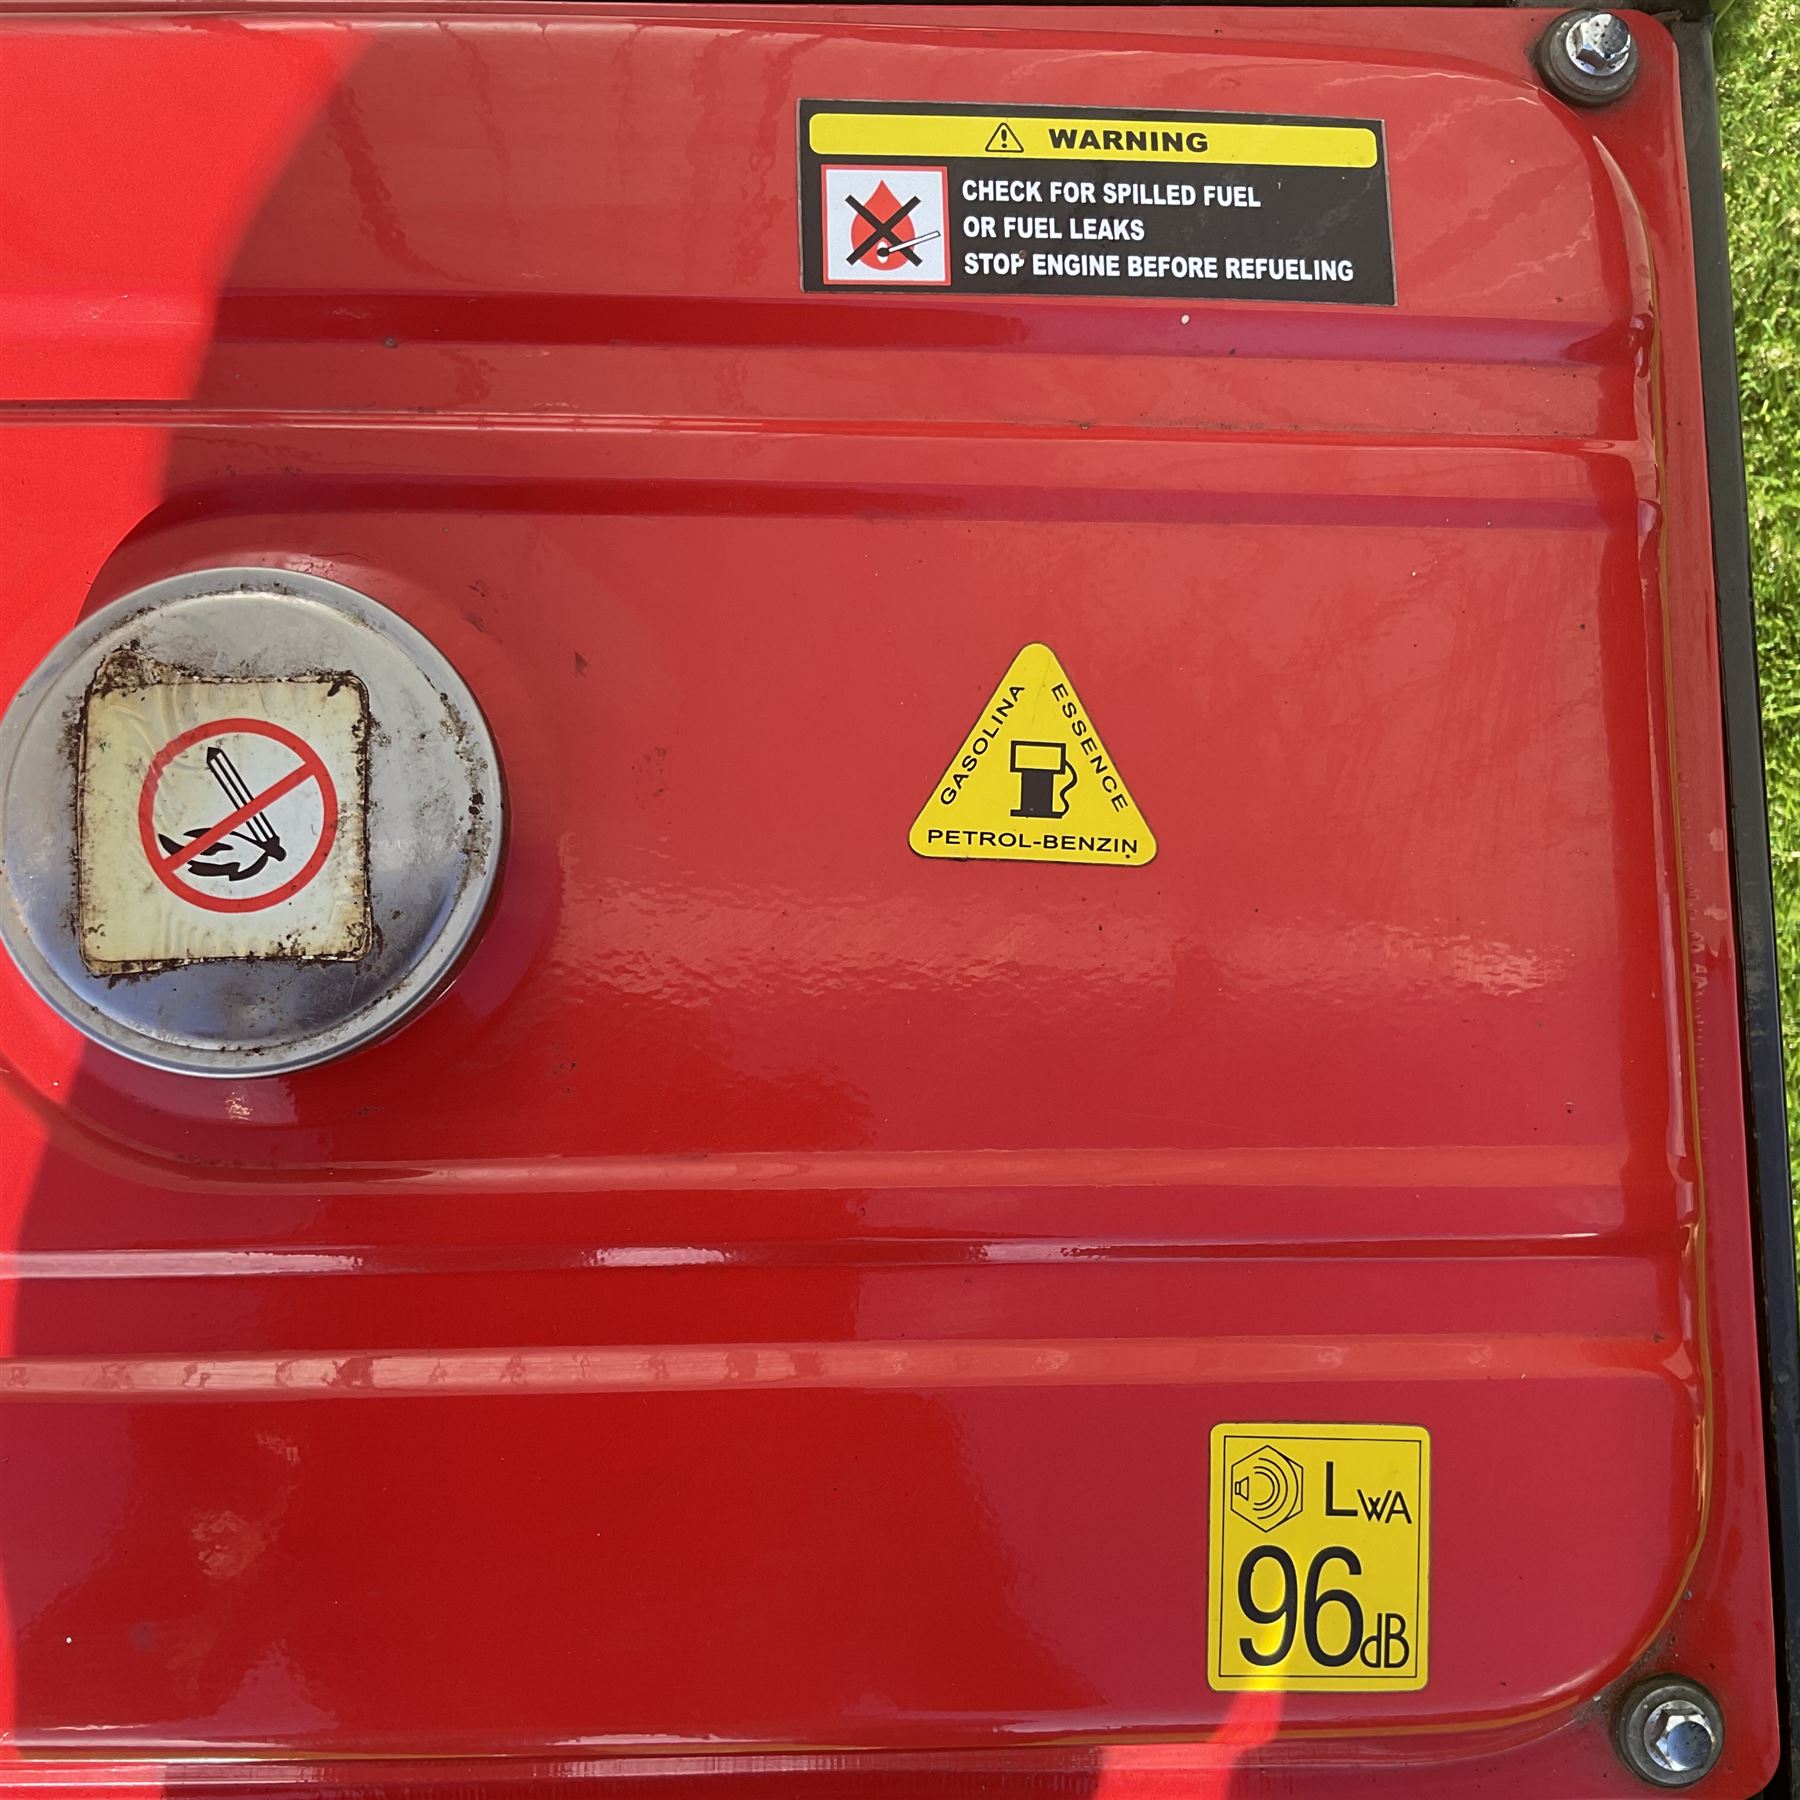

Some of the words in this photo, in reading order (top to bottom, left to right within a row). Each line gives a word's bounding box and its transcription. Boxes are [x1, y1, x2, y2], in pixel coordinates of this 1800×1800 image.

[1048, 127, 1209, 153] WARNING
[962, 179, 1045, 203] CHECK
[1050, 181, 1096, 204] FOR
[1103, 183, 1196, 207] SPILLED
[1203, 185, 1261, 208] FUEL
[963, 217, 997, 239] OR
[1003, 218, 1062, 240] FUEL
[1070, 219, 1145, 241] LEAKS
[964, 252, 1024, 275] STOP
[1032, 254, 1121, 277] ENGINE
[1128, 256, 1218, 279] BEFORE
[1225, 258, 1354, 282] REFUELING
[940, 685, 1025, 805] GASOLINA
[1051, 683, 1129, 812] ESSENCE
[927, 829, 1138, 853] PETROL-BENZIN
